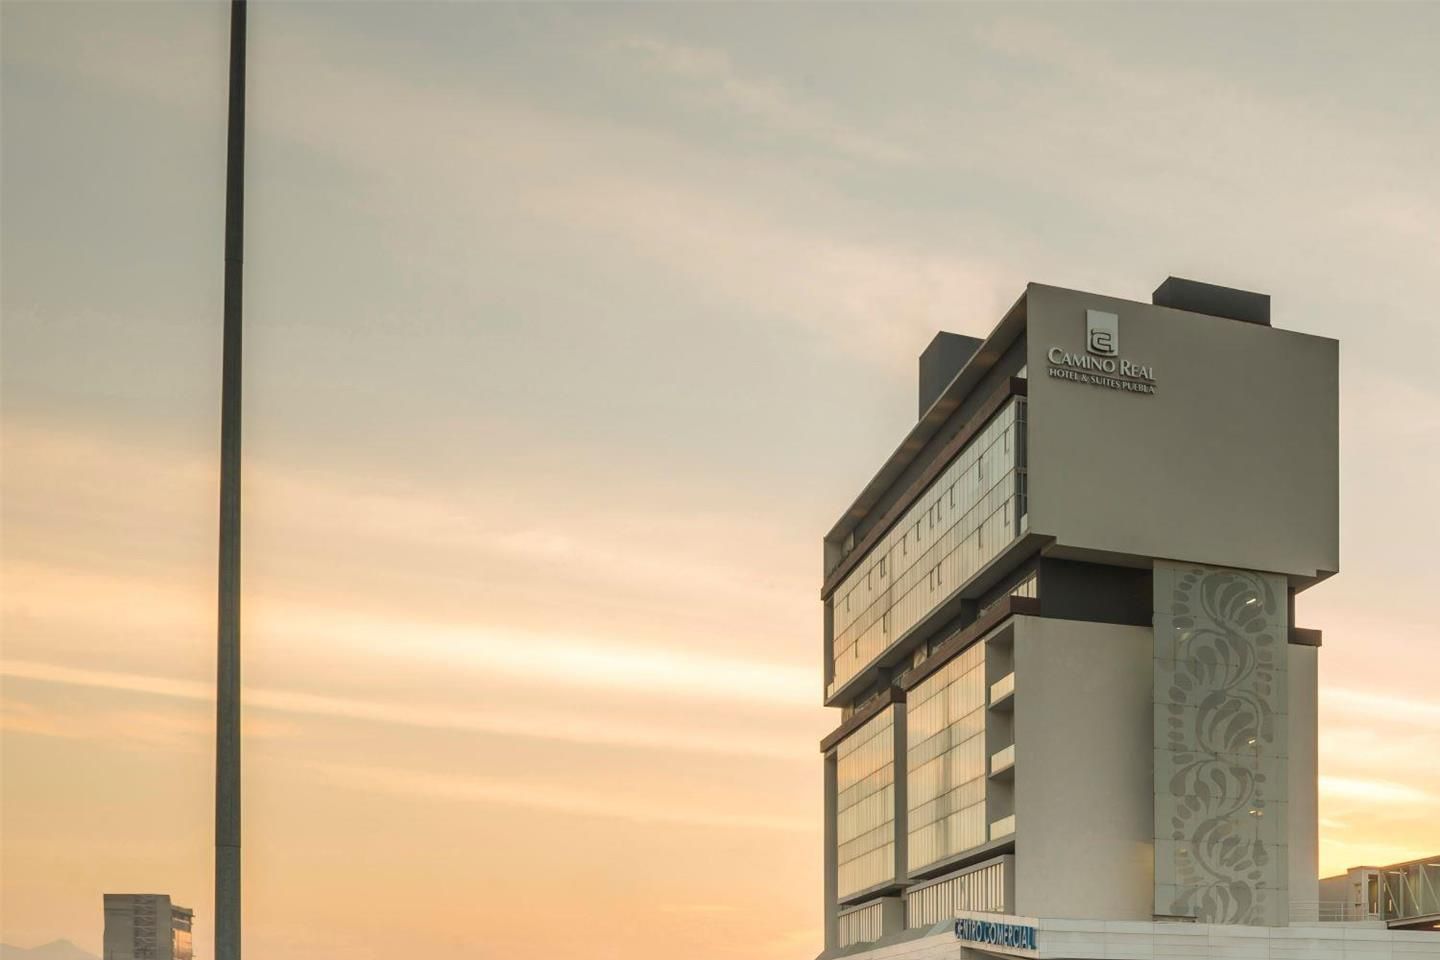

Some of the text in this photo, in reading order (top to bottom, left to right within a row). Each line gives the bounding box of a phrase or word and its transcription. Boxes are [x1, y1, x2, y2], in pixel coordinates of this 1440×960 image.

[1048, 347, 1156, 380] CAMINO REAL
[1049, 368, 1154, 395] HOTEL & SUITES PUEBLA
[955, 919, 1037, 950] CENTRO COMERCIAL
